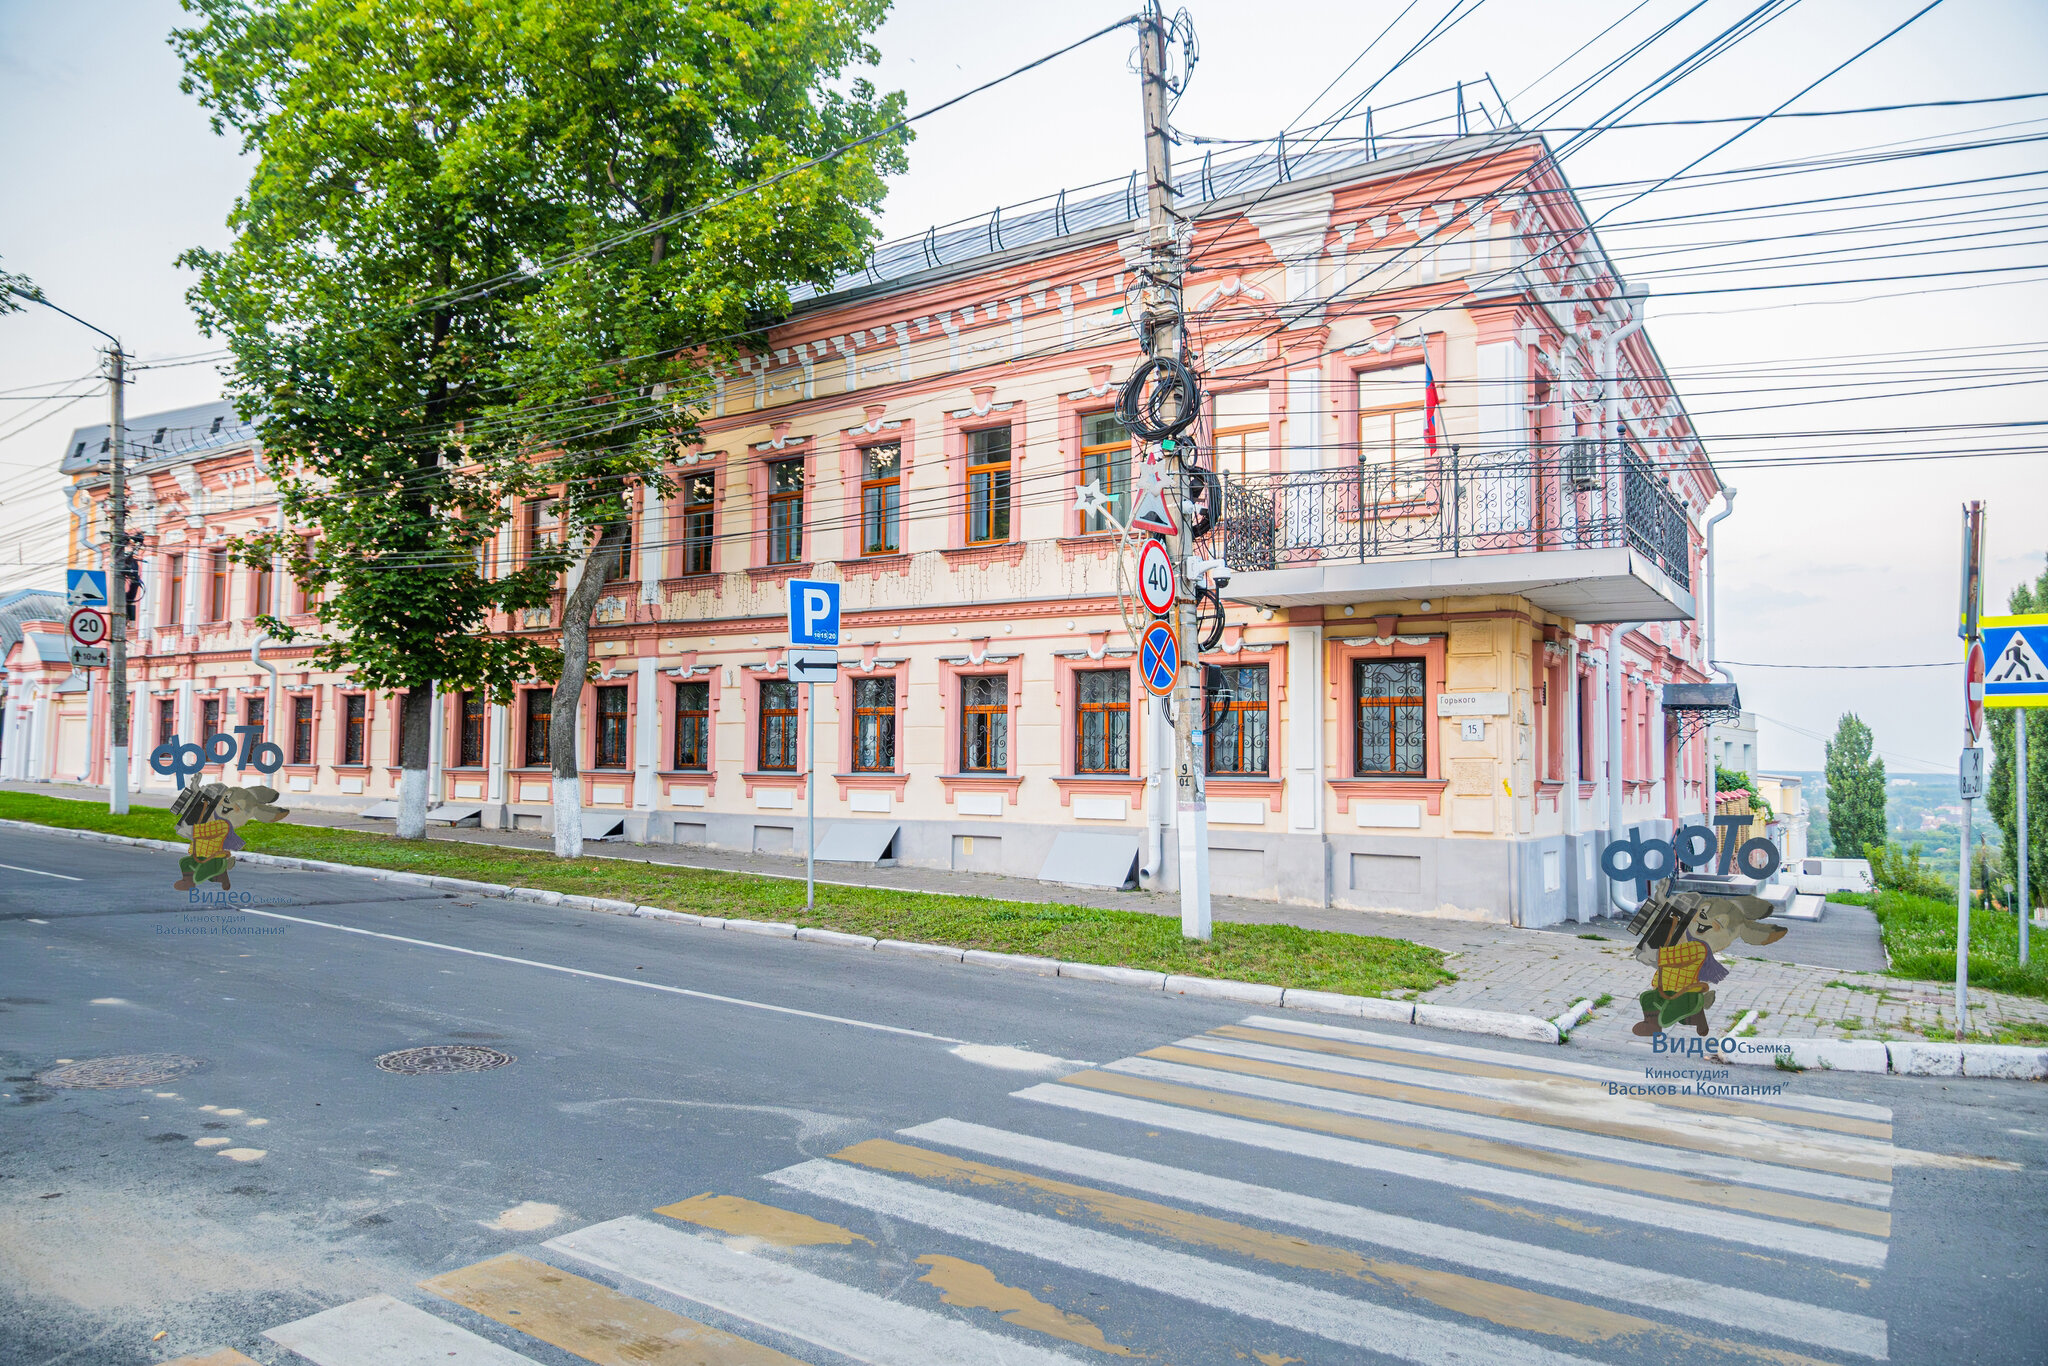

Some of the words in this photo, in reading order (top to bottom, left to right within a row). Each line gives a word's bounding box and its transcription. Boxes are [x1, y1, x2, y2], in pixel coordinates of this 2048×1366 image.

[1148, 563, 1168, 591] 40
[803, 588, 831, 637] P
[78, 618, 99, 632] 20
[1440, 696, 1476, 706] Горького
[1468, 724, 1477, 734] 15
[1182, 763, 1188, 775] 9
[1179, 777, 1190, 787] 01
